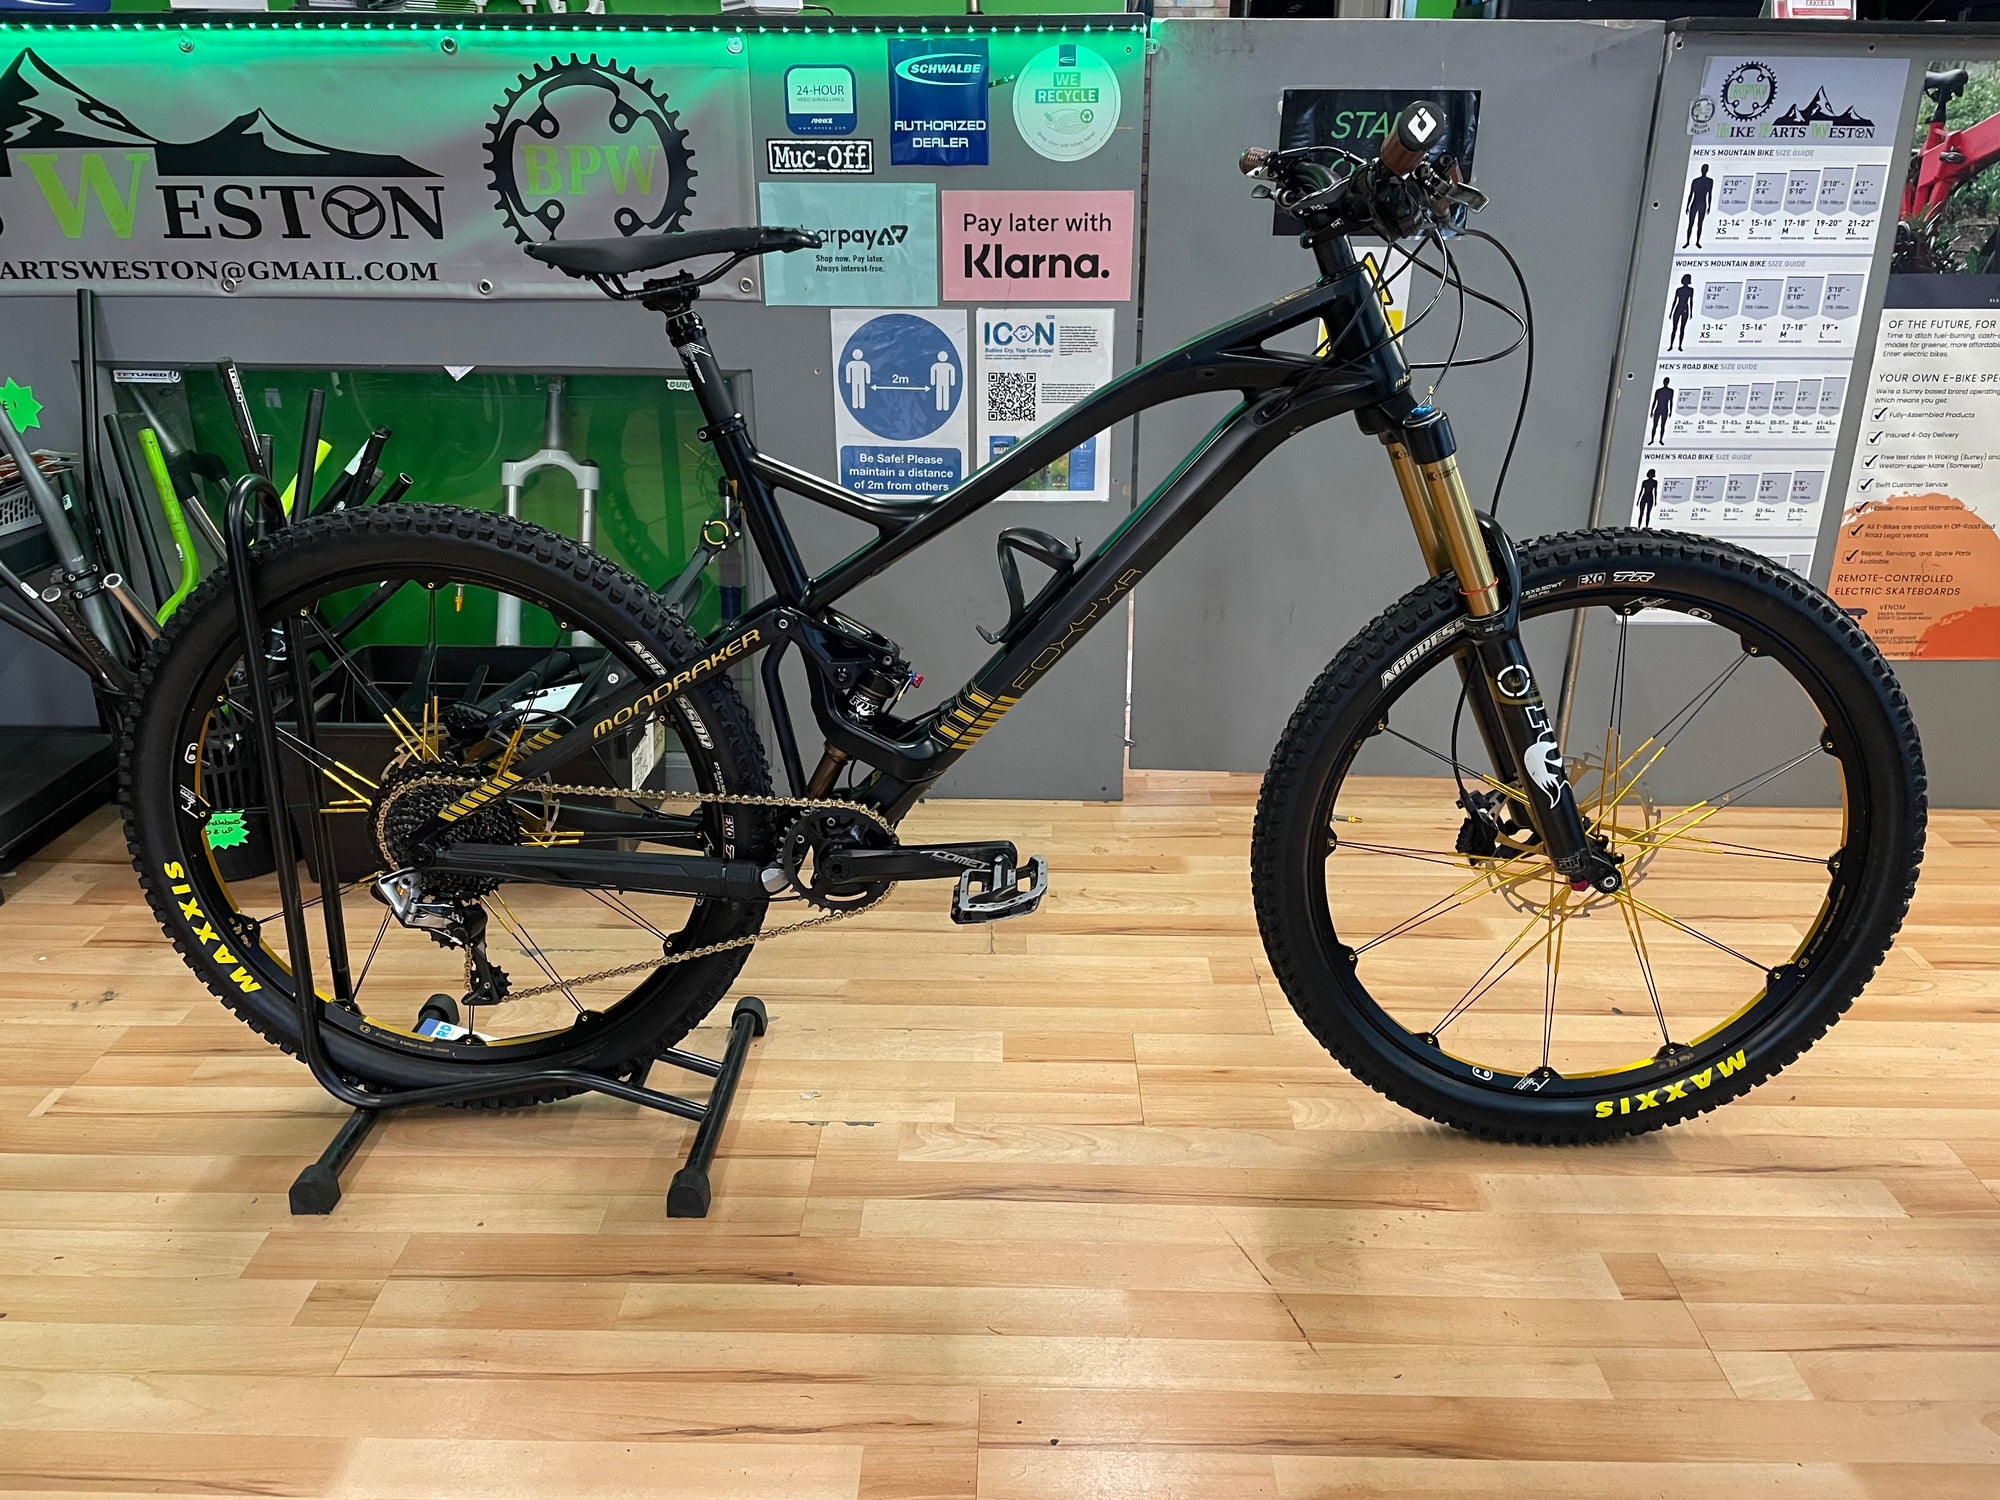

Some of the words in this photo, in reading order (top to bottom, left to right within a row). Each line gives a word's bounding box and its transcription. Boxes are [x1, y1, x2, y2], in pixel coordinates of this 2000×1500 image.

[911, 63, 982, 75] SCHWALBE
[1056, 74, 1078, 86] WE
[797, 85, 845, 95] 24-HOUR
[1039, 90, 1096, 102] RECYCLE
[895, 120, 986, 131] AUTHORIZED
[1716, 123, 1755, 138] BIKE
[1760, 123, 1806, 138] PARTS
[1811, 123, 1875, 139] WESTON
[913, 138, 969, 149] DEALER
[774, 146, 869, 169] Muc-Off
[519, 143, 661, 196] BPW
[963, 214, 1002, 237] Pay
[1009, 213, 1059, 232] later
[1065, 213, 1112, 232] with
[817, 230, 877, 250] arpay
[816, 255, 833, 263] Shop
[853, 255, 864, 263] Pay
[964, 244, 1110, 280] Klarna.
[816, 265, 839, 273] Always
[1889, 320, 1902, 329] OF
[1909, 320, 1927, 328] THE
[1931, 320, 1971, 330] FUTURE,
[1976, 320, 1997, 328] FOR
[892, 374, 910, 384] 2m
[1880, 374, 1908, 382] YOUR
[1943, 374, 1977, 382] E-BIKE
[1902, 389, 1923, 397] Surrey
[1889, 412, 1944, 420] Fully-Assembled
[1933, 432, 1959, 440] Delivery
[860, 454, 875, 465] Be
[877, 453, 905, 465] Safe!
[907, 454, 943, 465] Please
[1935, 454, 1959, 462] Woking
[1946, 462, 1984, 470] (Somerset)
[850, 466, 897, 477] maintain
[908, 468, 954, 478] distance
[854, 480, 865, 490] of
[868, 480, 884, 490] 2m
[886, 480, 912, 491] from
[915, 480, 950, 491] others
[1579, 574, 1605, 585] EXO
[1613, 572, 1655, 583] TR
[1837, 574, 1953, 583] REMOTE-CONTROLLED
[1835, 588, 1883, 596] ELECTRIC
[1886, 588, 1961, 596] SKATEBOARDS
[1381, 614, 1468, 689] AGGRESS
[593, 629, 761, 740] MONDRAKER
[164, 860, 263, 995] MAXXIS
[1595, 1049, 1748, 1119] MAXXIS
